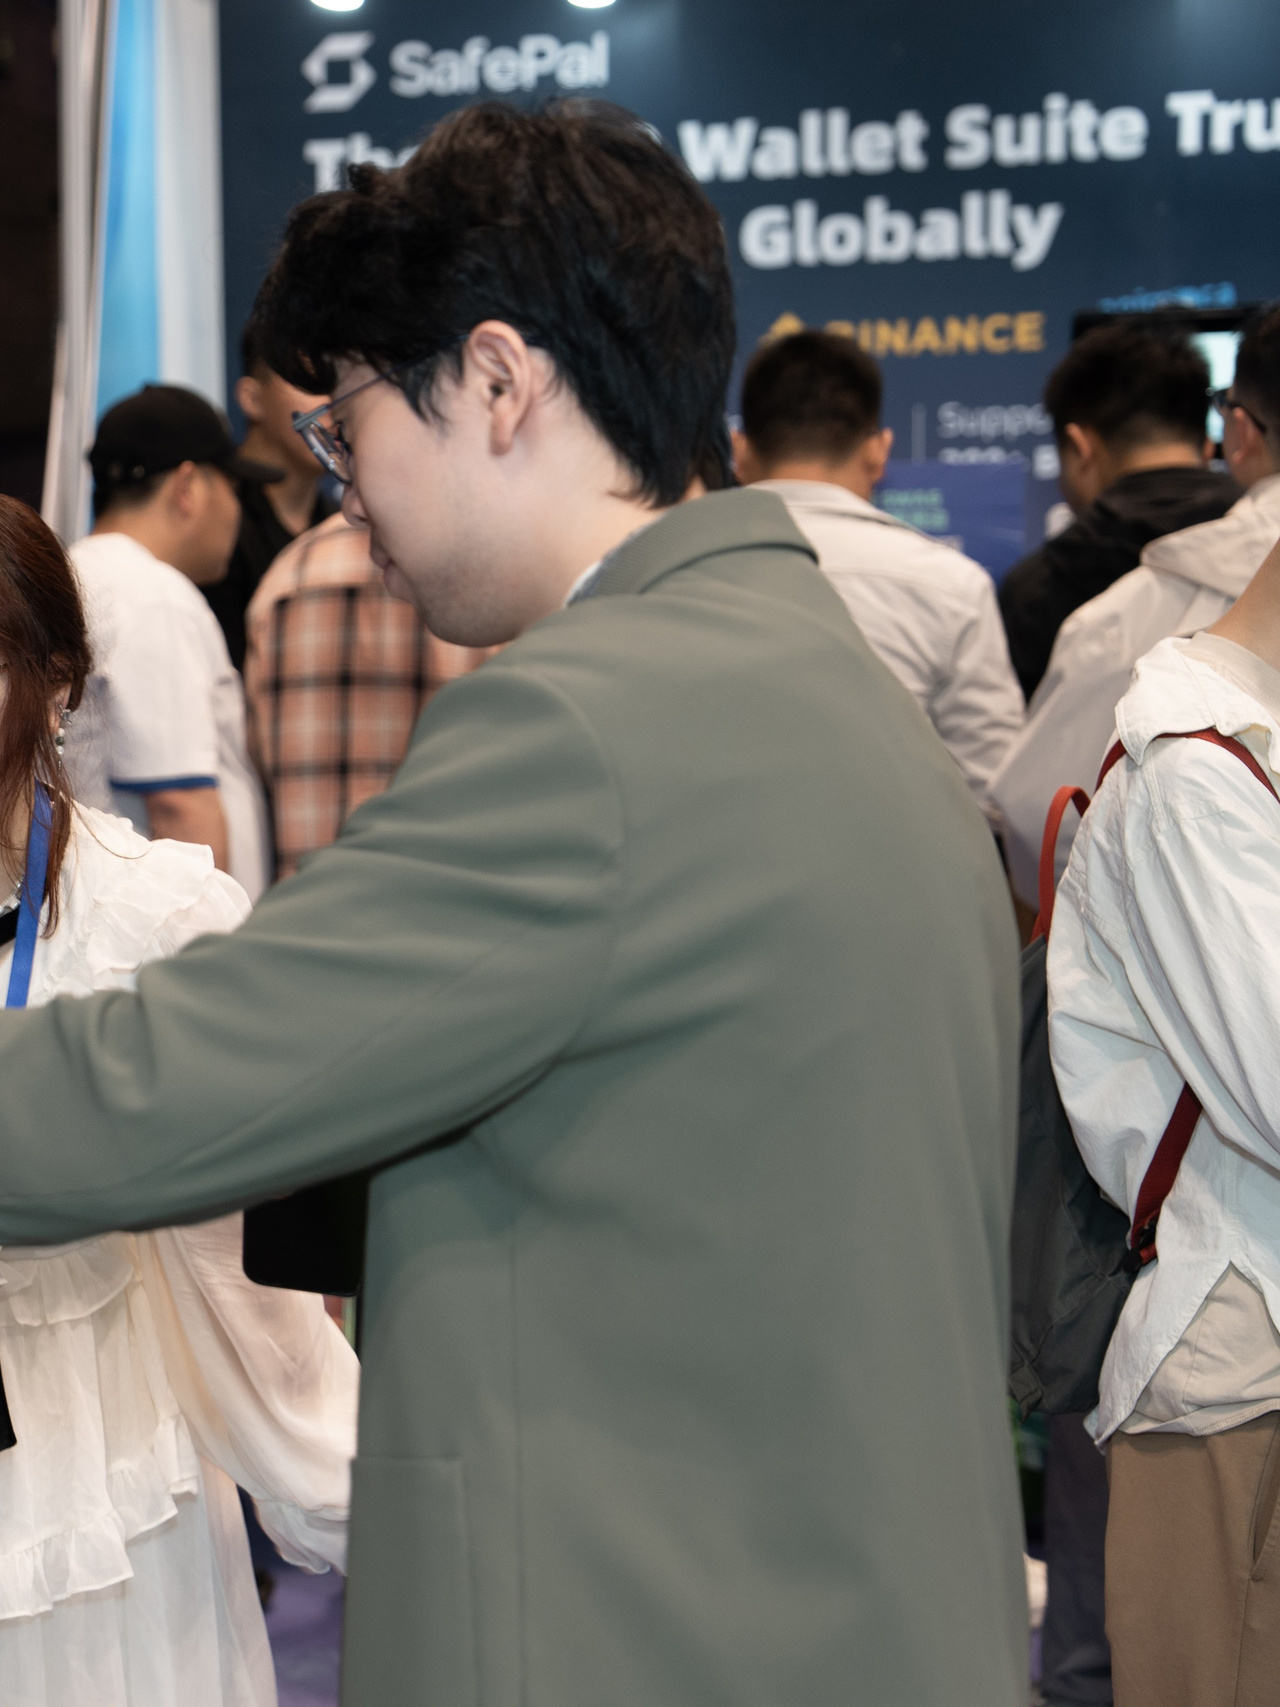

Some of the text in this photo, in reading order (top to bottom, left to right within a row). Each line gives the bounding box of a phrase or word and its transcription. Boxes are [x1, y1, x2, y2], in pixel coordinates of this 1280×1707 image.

[390, 31, 609, 97] SafePal
[678, 107, 928, 182] Wallet
[944, 92, 1148, 170] Suite
[1165, 89, 1280, 157] Tru
[739, 188, 1063, 271] Globally
